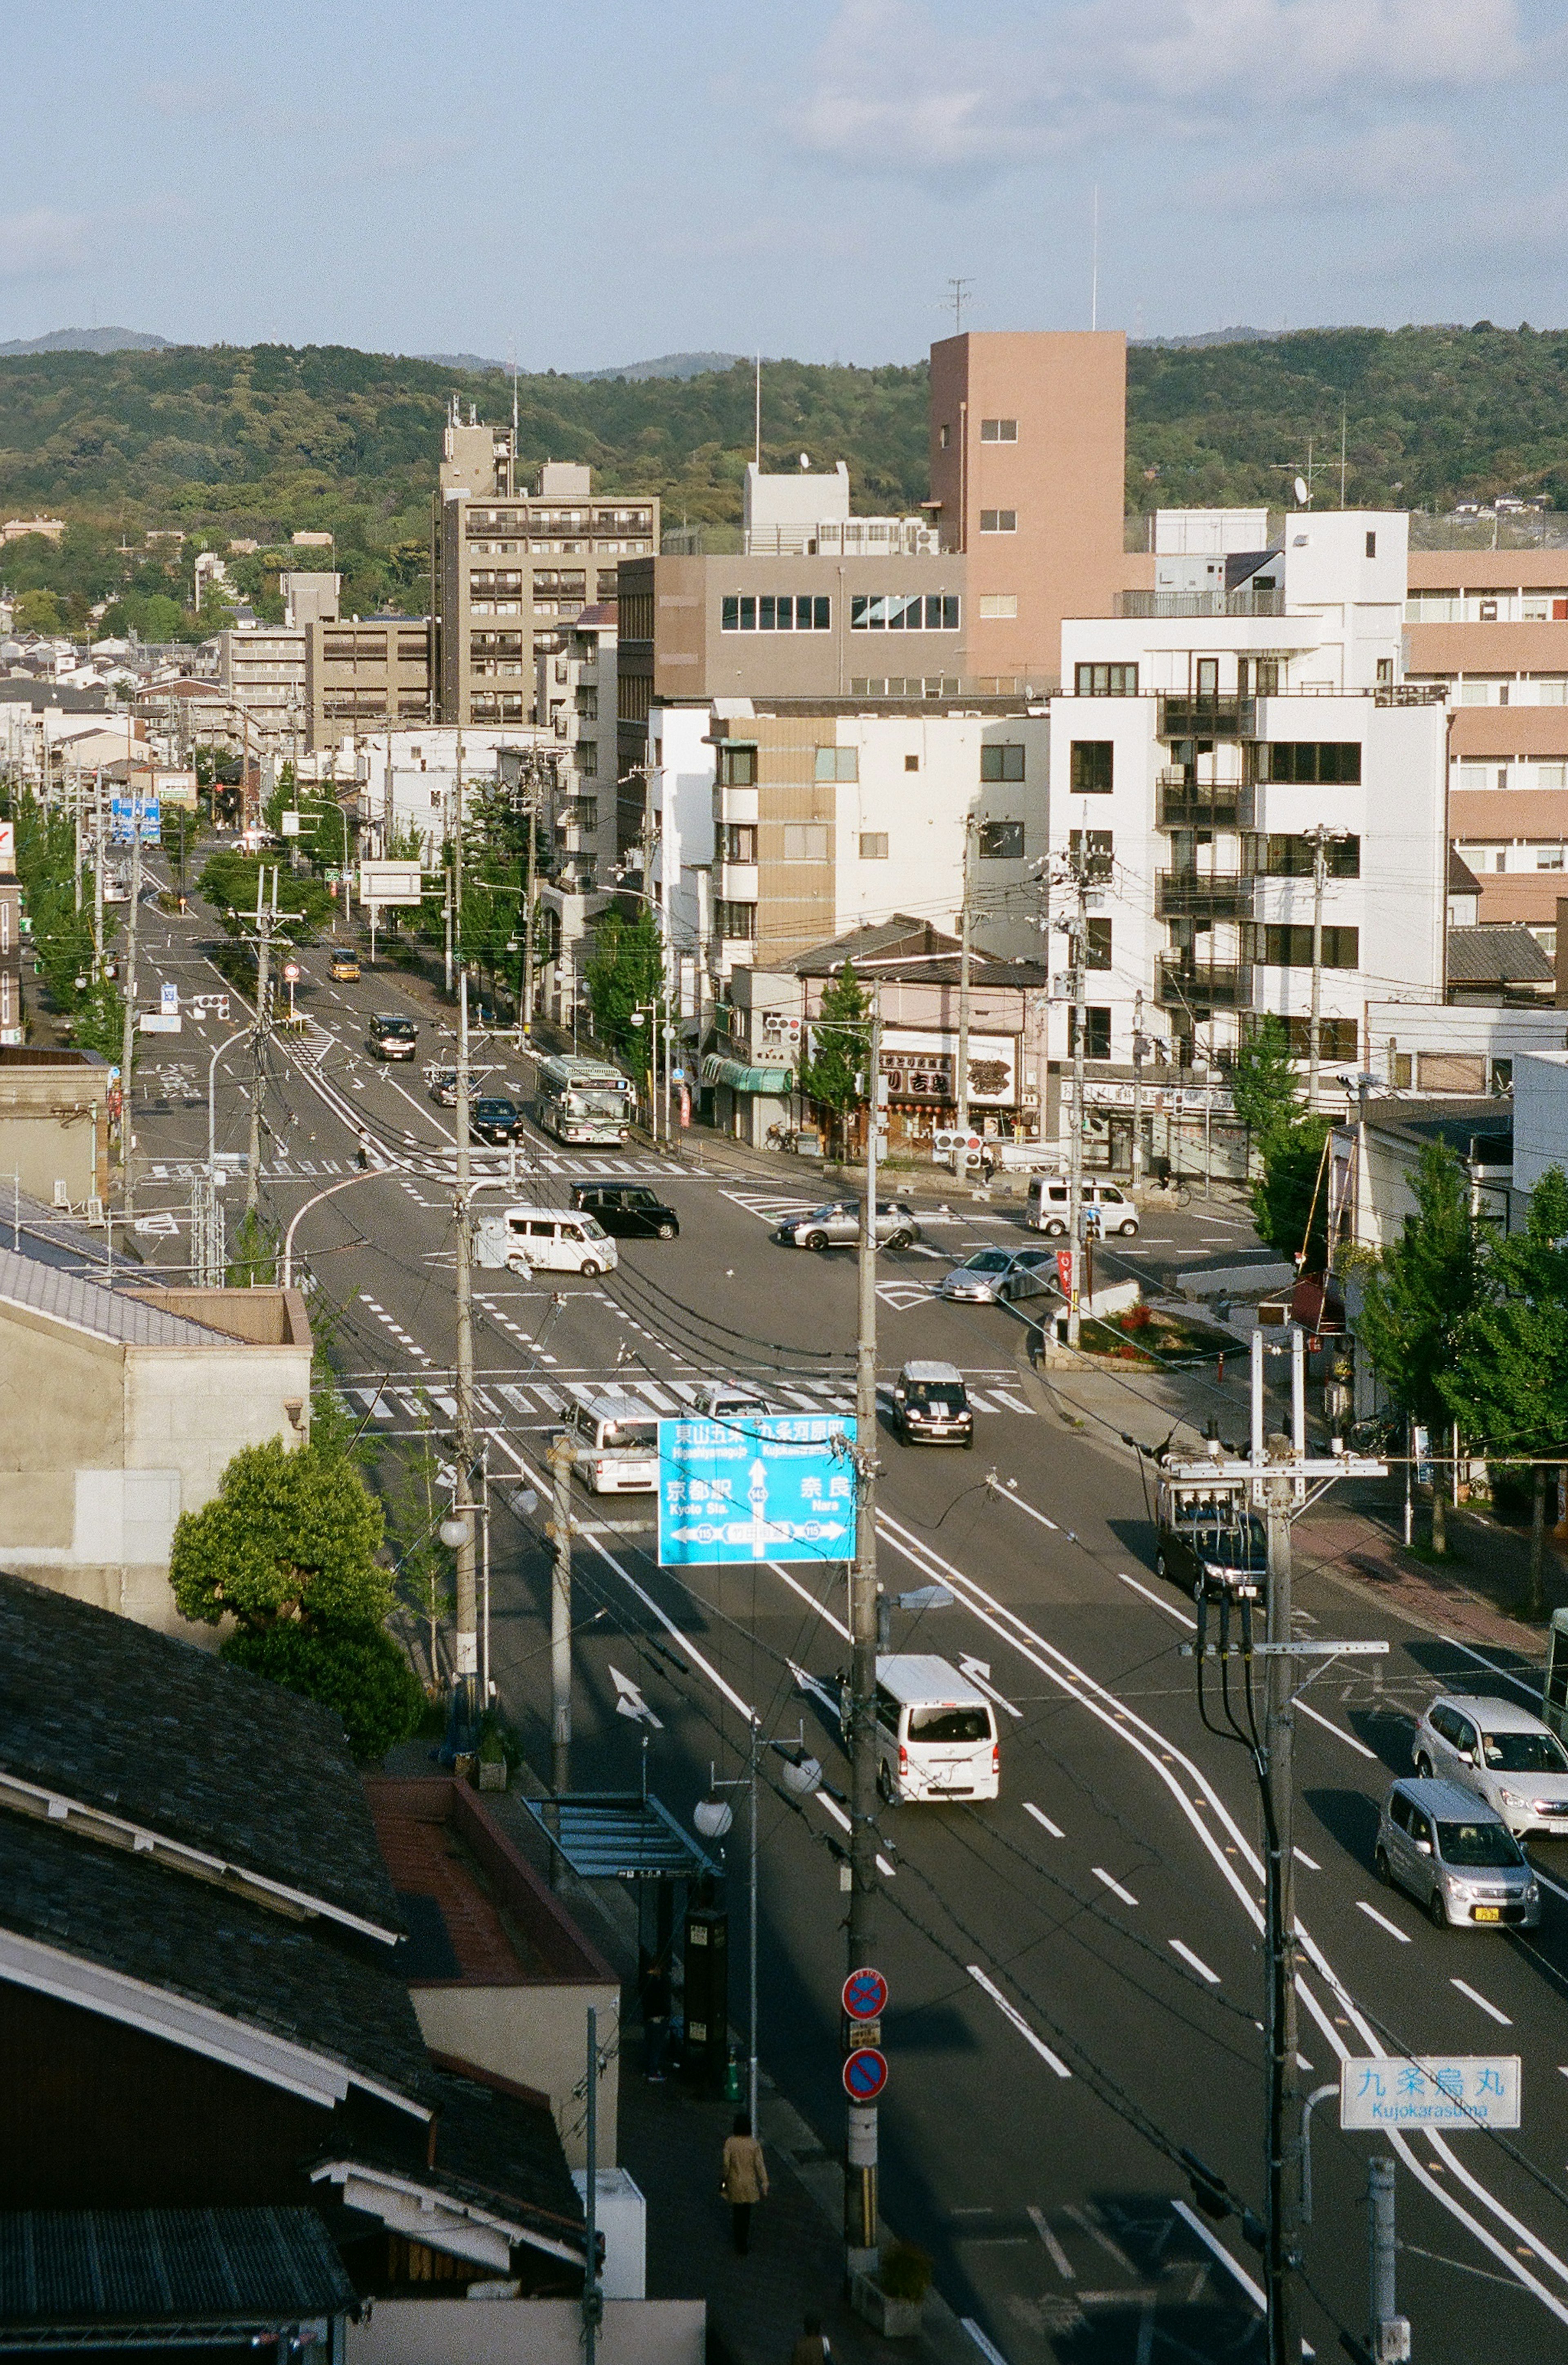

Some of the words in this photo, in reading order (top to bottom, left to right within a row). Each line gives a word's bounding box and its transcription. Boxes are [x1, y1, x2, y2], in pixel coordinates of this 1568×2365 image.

[675, 1423, 746, 1444] 東山五条
[758, 1420, 844, 1442] 九条河原町
[666, 1479, 732, 1501] 京都駅
[801, 1476, 851, 1498] 奈良
[670, 1503, 702, 1516] Kyoto
[706, 1503, 728, 1514] Sta.
[812, 1500, 839, 1511] Nara
[699, 1529, 713, 1538] 115
[806, 1526, 820, 1535] 115
[1357, 2067, 1506, 2097] 九条烏丸
[1372, 2102, 1488, 2121] Kujokarasuma
